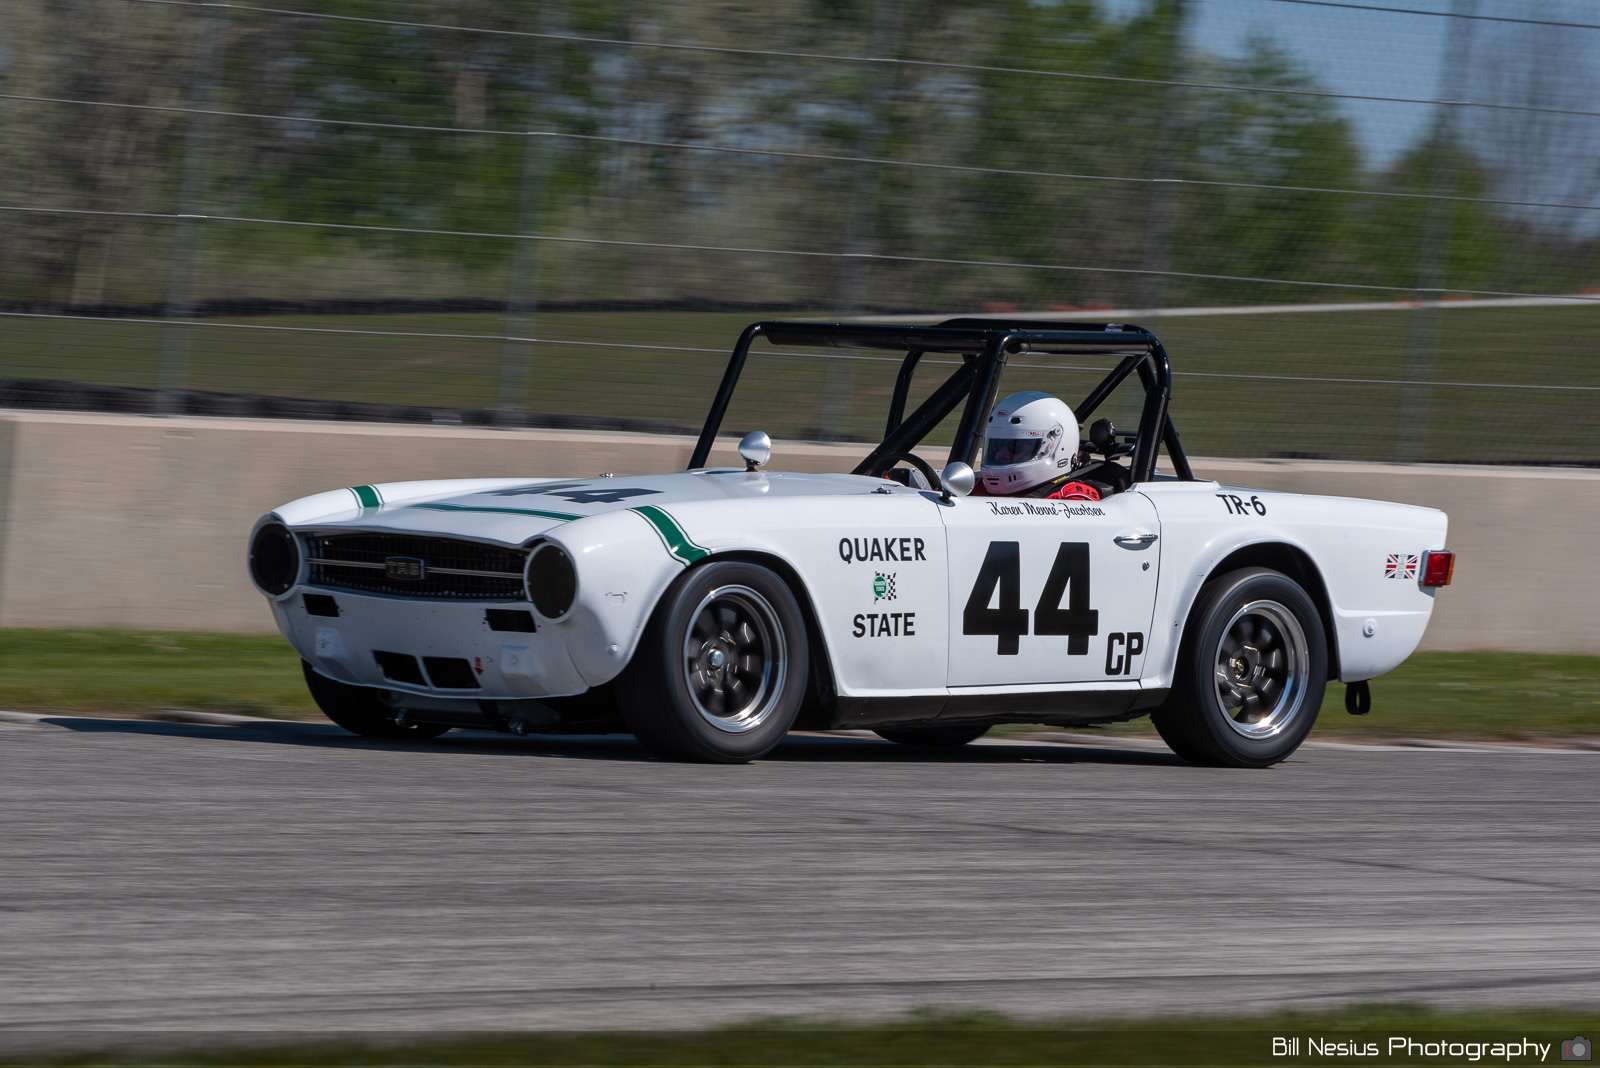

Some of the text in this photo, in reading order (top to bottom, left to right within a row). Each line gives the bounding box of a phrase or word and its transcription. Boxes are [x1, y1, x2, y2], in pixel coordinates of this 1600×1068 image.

[986, 501, 1024, 516] Karen
[1215, 494, 1267, 517] TR-6
[839, 537, 927, 564] QUAKER
[963, 541, 1099, 656] 44
[852, 612, 916, 639] STATE
[1105, 632, 1144, 676] CP
